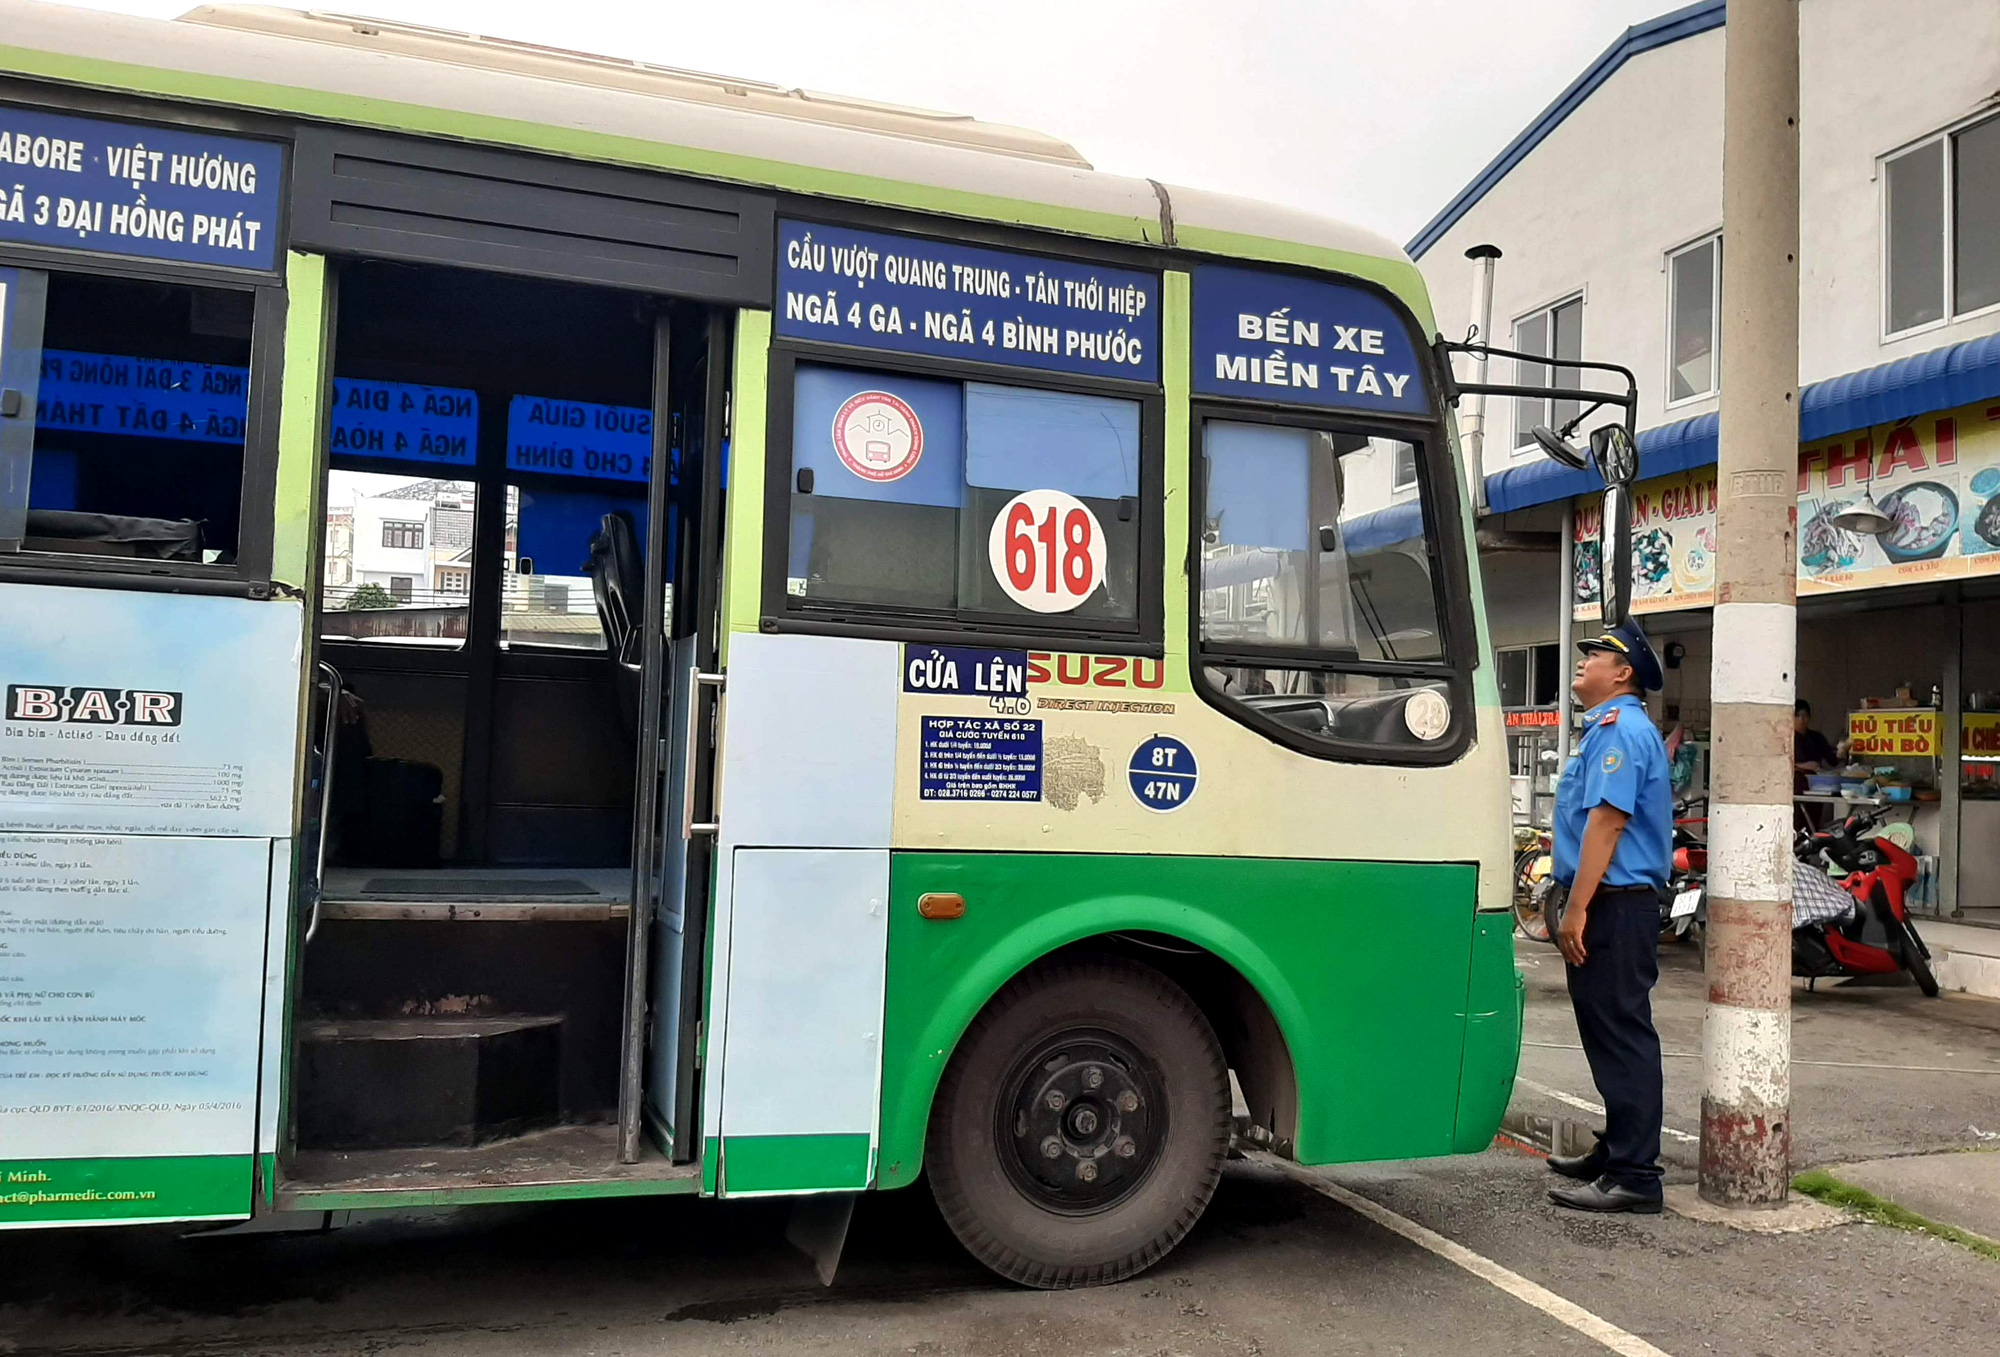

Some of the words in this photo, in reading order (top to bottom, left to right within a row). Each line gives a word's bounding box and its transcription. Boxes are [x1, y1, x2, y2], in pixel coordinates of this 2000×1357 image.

[106, 143, 163, 190] VIỆT
[170, 152, 256, 194] HƯƠNG
[34, 195, 49, 226] 3
[57, 197, 103, 238] ĐẠI
[109, 193, 184, 242] HỒNG
[191, 212, 261, 251] PHÁT
[787, 232, 825, 272] CẦU
[831, 245, 879, 289] VƯỢT
[884, 255, 947, 291] QUANG
[952, 265, 1011, 299] TRUNG
[1025, 271, 1060, 306] TÂN
[1064, 277, 1104, 311] THỚI
[1107, 284, 1147, 323] HIỆP
[786, 290, 840, 327] NGÃ
[847, 303, 861, 329] 4
[869, 304, 903, 335] GA
[924, 309, 975, 345] NGÃ
[981, 320, 995, 346] 4
[1002, 315, 1059, 355] BÌNH
[1065, 328, 1143, 365] PHƯỚC
[1238, 307, 1320, 347] BẾN
[1333, 325, 1385, 355] XE
[1215, 349, 1319, 389] MIỀN
[1330, 364, 1411, 398] TÂY
[1798, 415, 1958, 494] THÁI
[1631, 494, 1650, 529] N
[1005, 502, 1093, 596] 618
[908, 649, 959, 690] CỬA
[975, 656, 1022, 693] LÊN
[929, 719, 954, 730] HỢP
[957, 719, 981, 730] TÁC
[984, 720, 1000, 730] XÃ
[1003, 720, 1020, 731] SỐ
[1022, 723, 1036, 732] 22
[1037, 698, 1093, 711] DIRECT
[1097, 700, 1176, 714] INJECTION
[1851, 714, 1878, 734] HỦ
[1884, 713, 1933, 734] TIẾU
[1152, 747, 1178, 767] 8T
[1852, 735, 1894, 753] BÚN
[1900, 734, 1930, 753] BÒ
[1008, 790, 1021, 799] 224
[1144, 781, 1180, 800] 47N
[8, 1170, 52, 1183] Minh.
